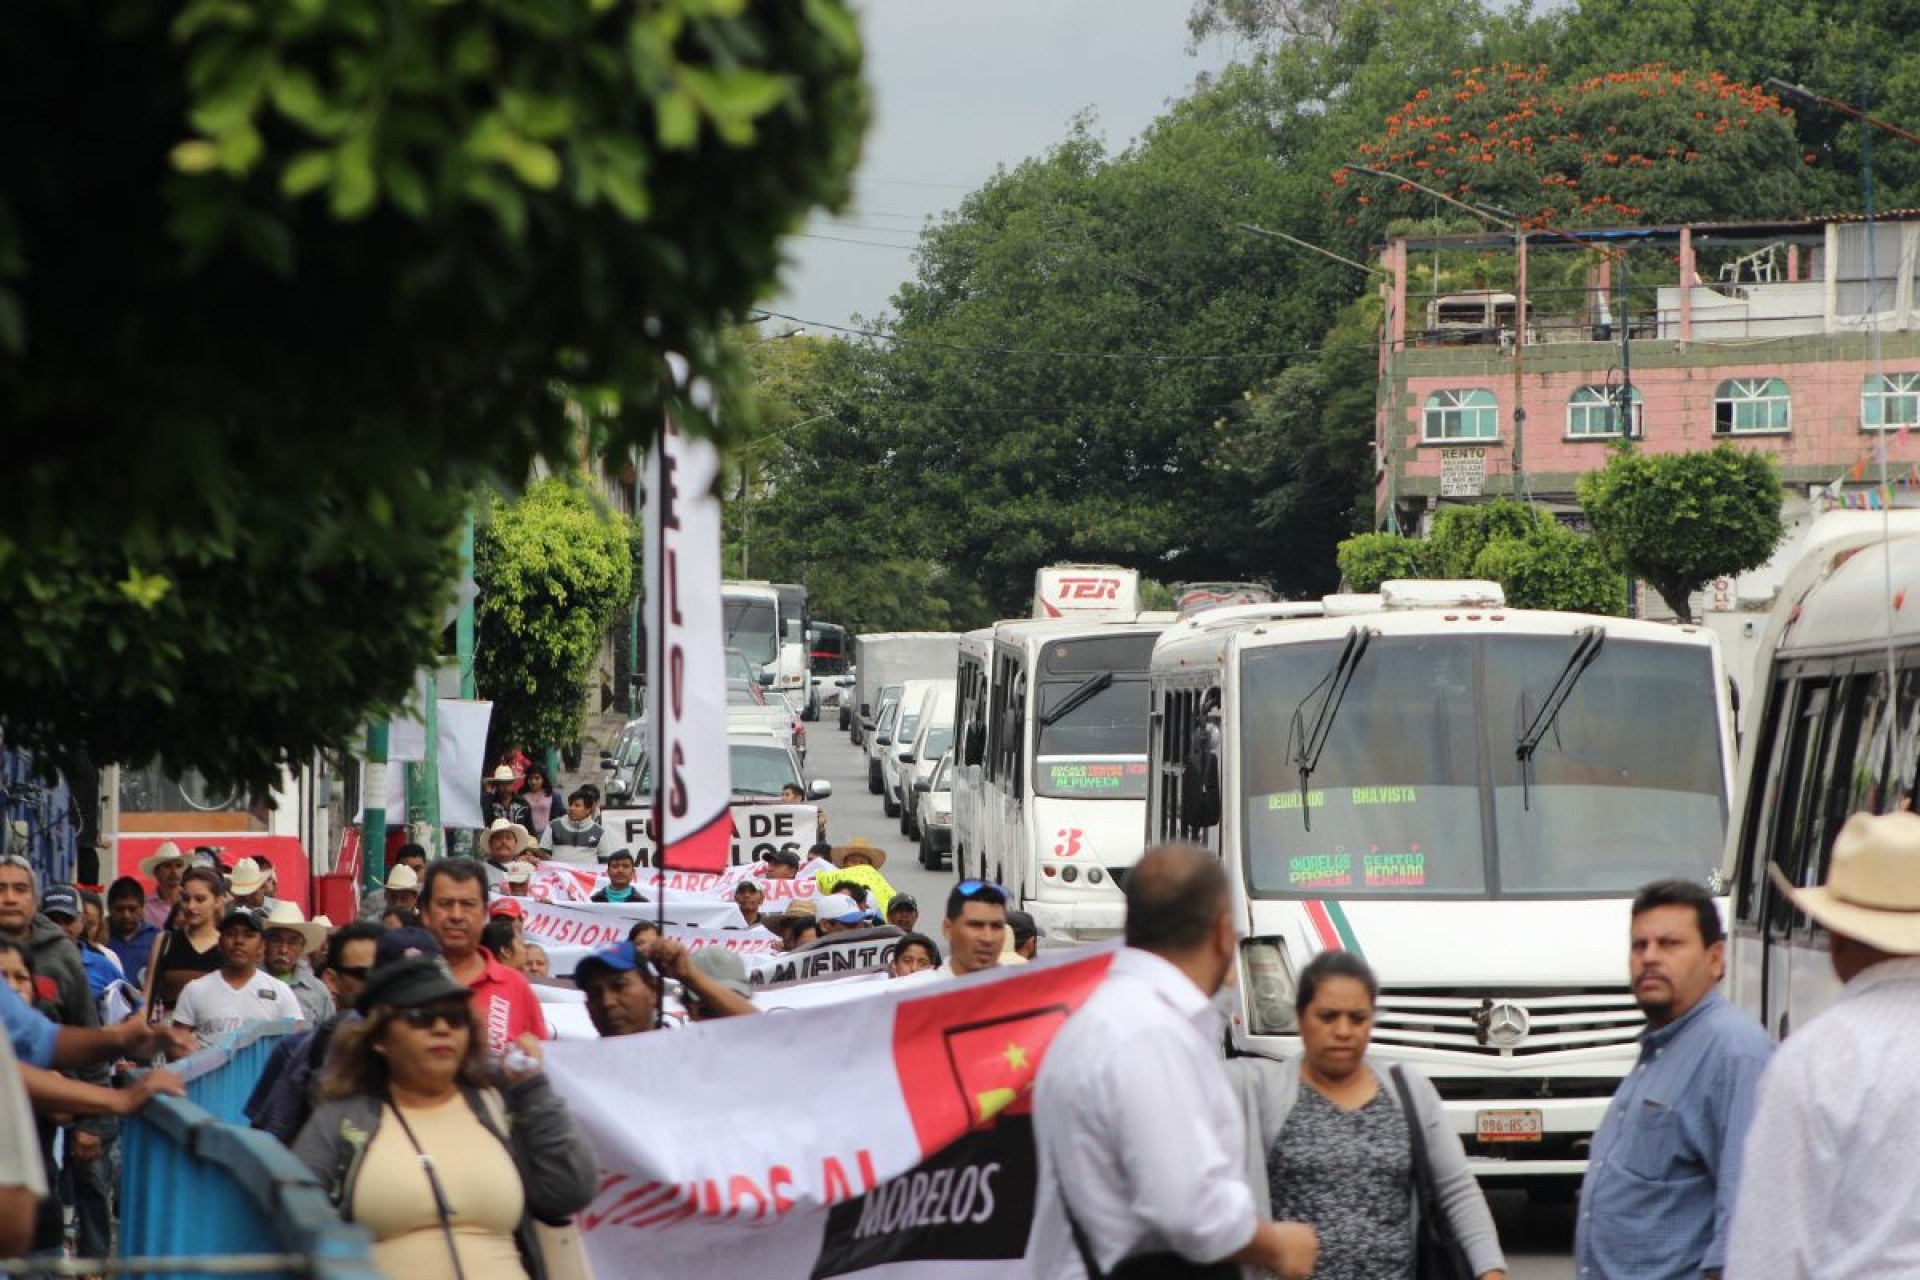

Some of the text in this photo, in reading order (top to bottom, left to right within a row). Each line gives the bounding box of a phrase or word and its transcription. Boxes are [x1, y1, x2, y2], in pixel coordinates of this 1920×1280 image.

[1442, 447, 1485, 459] RENTO
[1058, 577, 1121, 600] TER
[750, 813, 794, 838] DE
[1055, 828, 1083, 857] 3
[853, 1162, 1001, 1239] MORELOS
